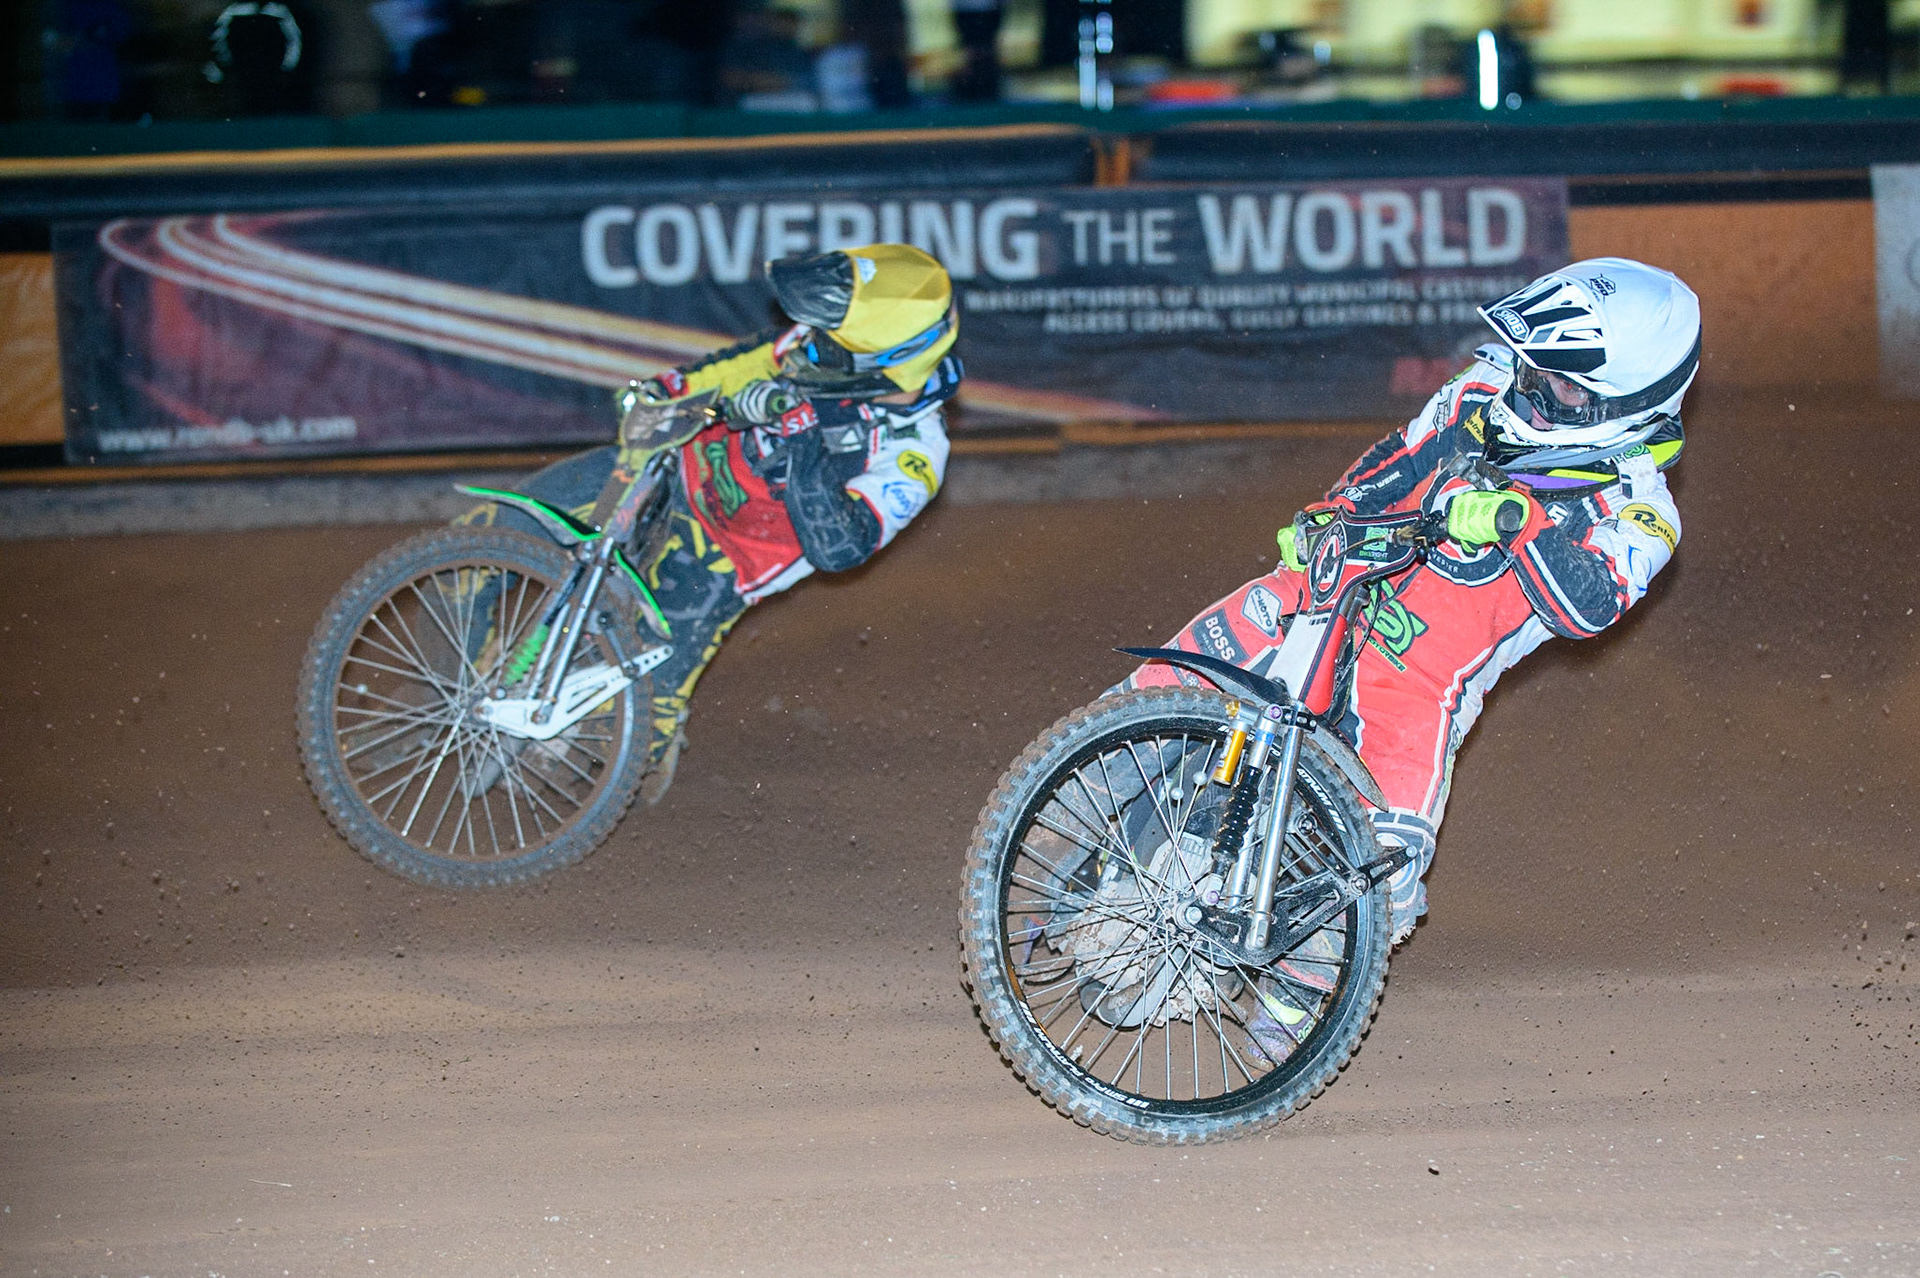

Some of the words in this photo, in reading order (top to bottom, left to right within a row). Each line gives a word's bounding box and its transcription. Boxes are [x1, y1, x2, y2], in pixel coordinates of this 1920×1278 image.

[581, 198, 1041, 289] COVERING
[1062, 208, 1178, 266] THE
[1199, 188, 1527, 275] WORLD
[1497, 309, 1527, 337] SHOEI
[1254, 589, 1273, 627] C-MOTO
[1205, 615, 1236, 661] BOSS
[1368, 637, 1407, 672] OTORBIKE
[1034, 1027, 1084, 1078] PLATINUM
